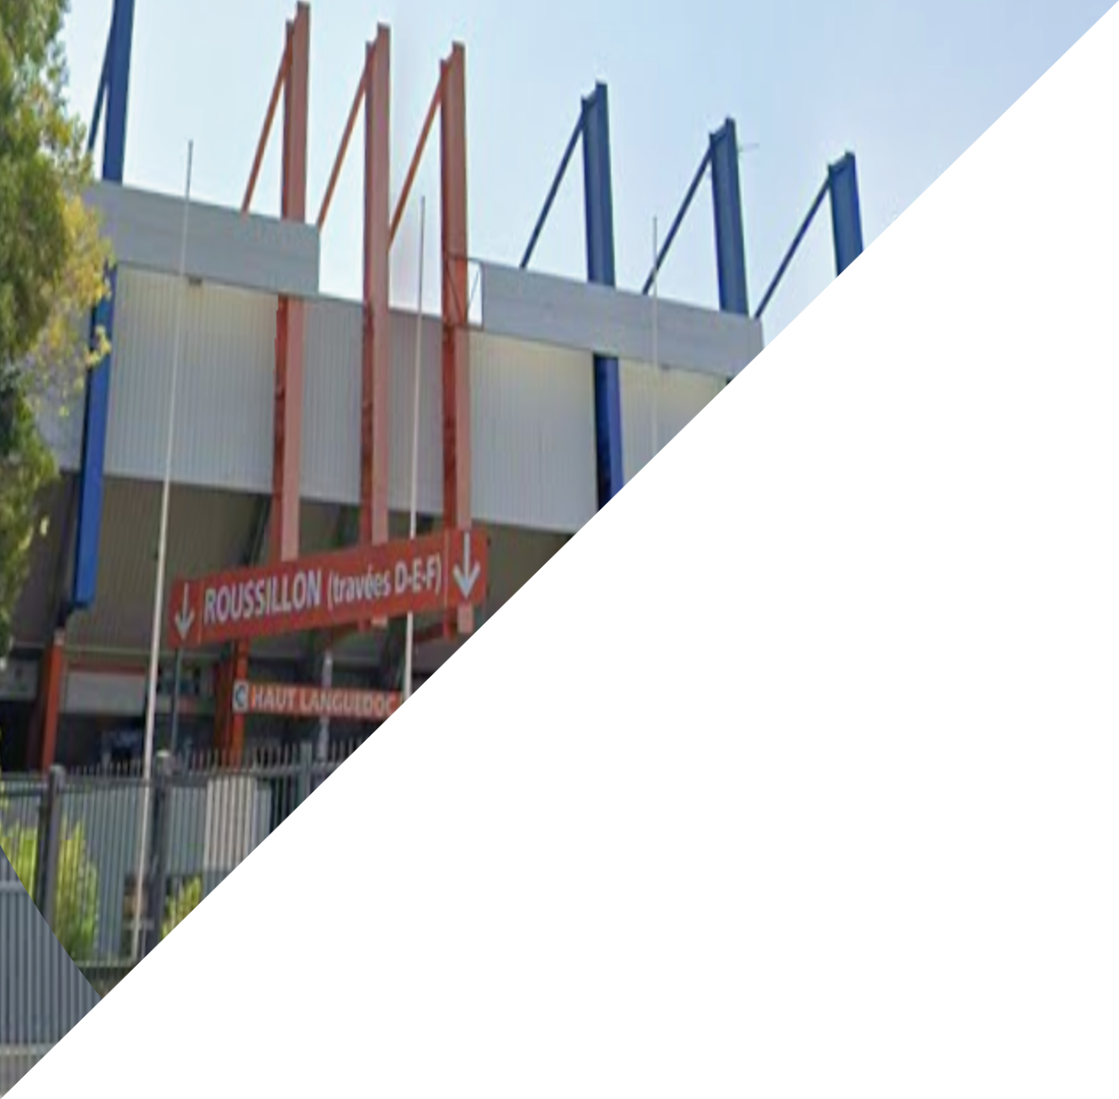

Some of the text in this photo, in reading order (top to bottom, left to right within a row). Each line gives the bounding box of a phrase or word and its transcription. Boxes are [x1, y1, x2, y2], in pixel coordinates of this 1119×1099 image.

[203, 570, 322, 625] ROUSSILLON
[327, 563, 391, 611] (travées
[252, 685, 295, 713] HAUT
